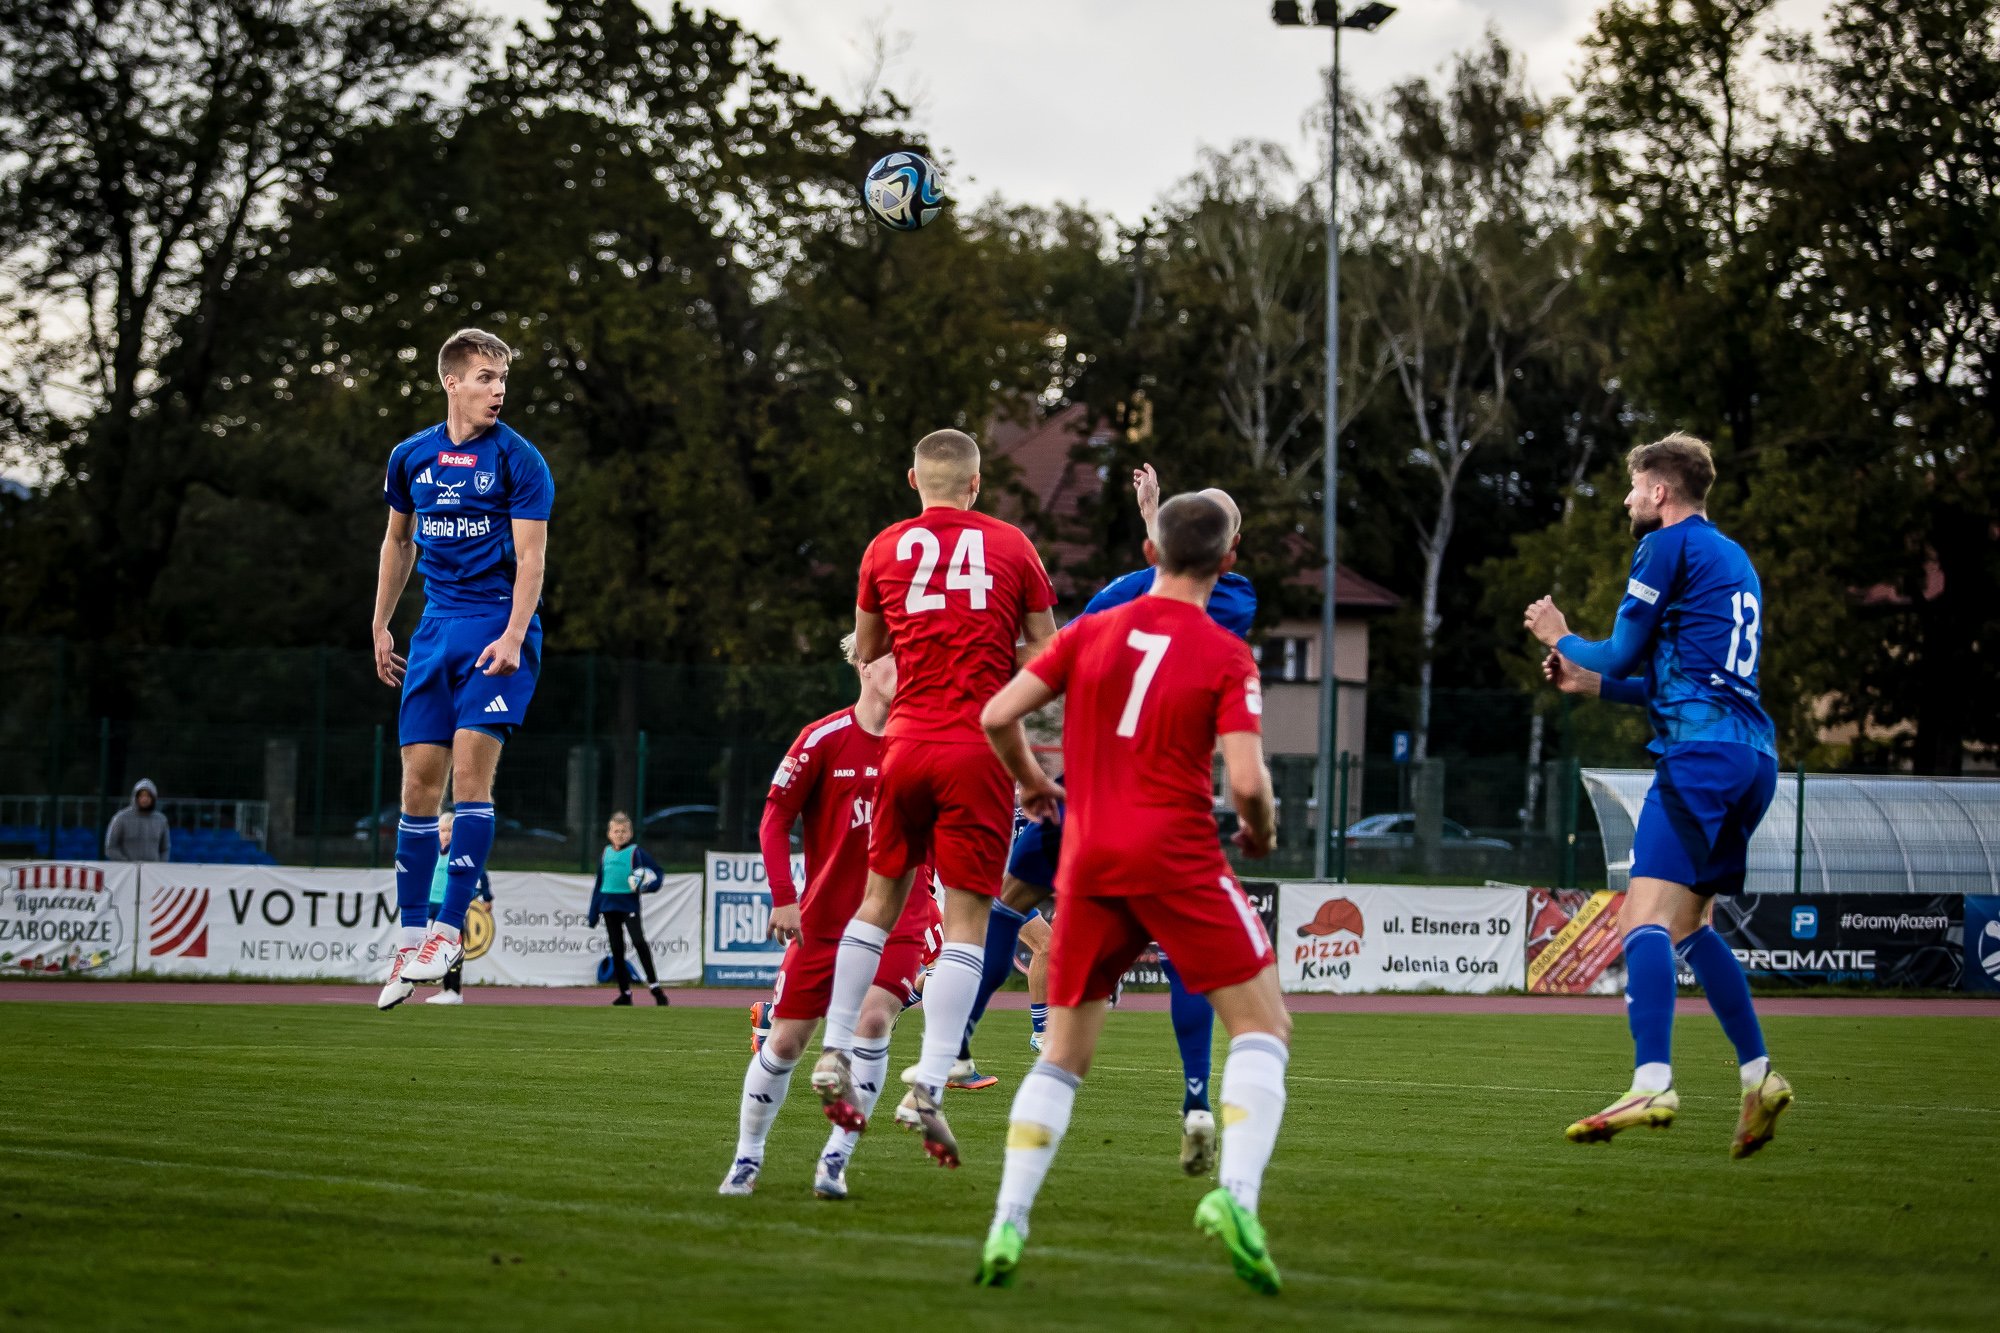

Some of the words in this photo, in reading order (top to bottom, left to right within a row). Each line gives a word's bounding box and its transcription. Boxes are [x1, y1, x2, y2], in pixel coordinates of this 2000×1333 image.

[441, 454, 474, 466] Betclic
[457, 515, 490, 537] Plast
[896, 527, 993, 614] 24
[1725, 592, 1760, 678] 13
[1116, 629, 1171, 738] 7
[833, 769, 855, 777] JAKO
[229, 888, 400, 928] VOTUM
[503, 908, 549, 928] Salon
[0, 920, 112, 942] ZABOBRZE
[719, 895, 769, 950] psb
[1384, 917, 1404, 934] ul.
[1412, 917, 1480, 936] Elsnera
[1487, 917, 1511, 936] 3D
[1840, 913, 1948, 934] #GramyRazem
[241, 941, 357, 961] NETWORK
[502, 935, 584, 957] Pojazdów
[1295, 939, 1361, 963] pizza
[1382, 955, 1449, 974] Jelenia
[1456, 954, 1499, 975] Góra
[1731, 949, 1876, 970] PROMATIC
[1301, 961, 1352, 981] King
